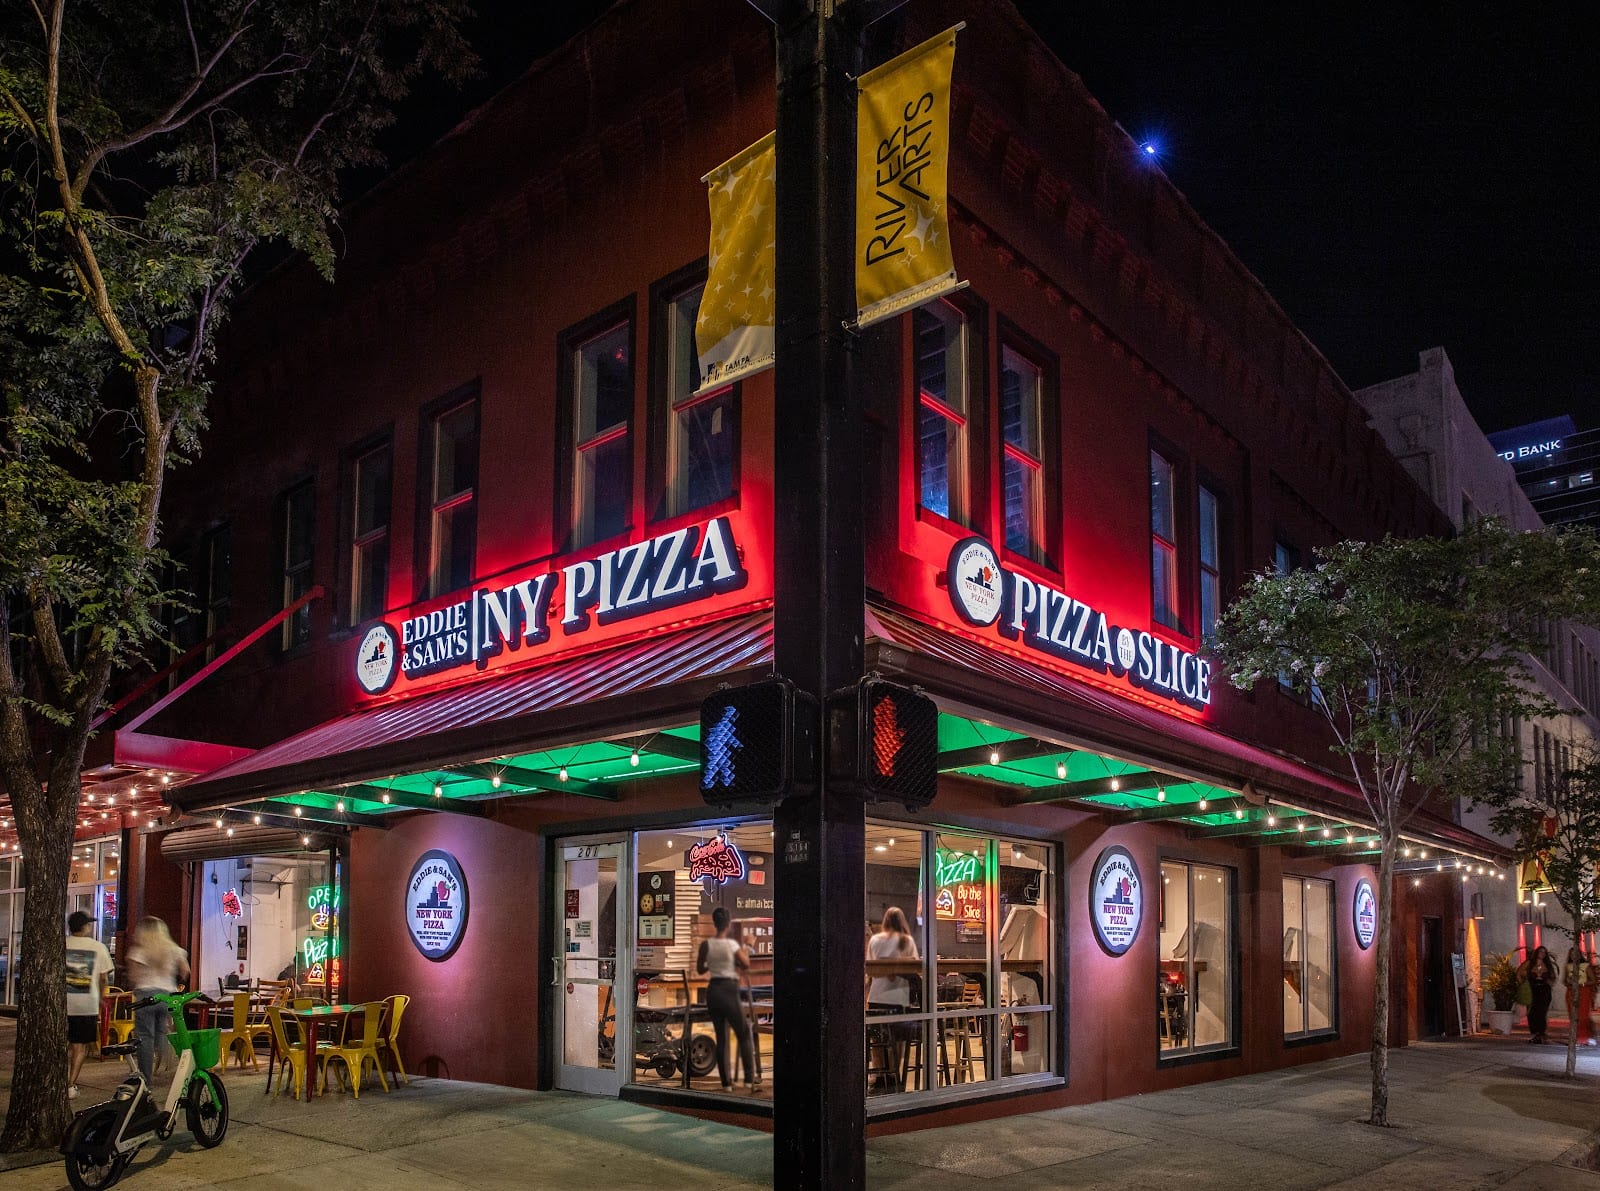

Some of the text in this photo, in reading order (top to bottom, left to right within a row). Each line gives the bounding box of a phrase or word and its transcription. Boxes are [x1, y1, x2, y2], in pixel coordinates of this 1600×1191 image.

[898, 91, 934, 202] ARTS
[866, 126, 905, 266] RIVER
[725, 355, 751, 372] TAMPA
[481, 519, 736, 649] NY PIZZA
[401, 601, 468, 645] EDDIE
[1011, 572, 1211, 704] PIZZA SLICE
[577, 846, 599, 858] 201
[412, 865, 433, 893] EDDIE
[969, 885, 982, 900] the
[415, 909, 453, 920] NEW YORK
[964, 904, 981, 919] Slice
[1103, 904, 1134, 915] NEW YORK
[423, 919, 445, 930] PIZZA
[1109, 915, 1128, 925] PIZZA
